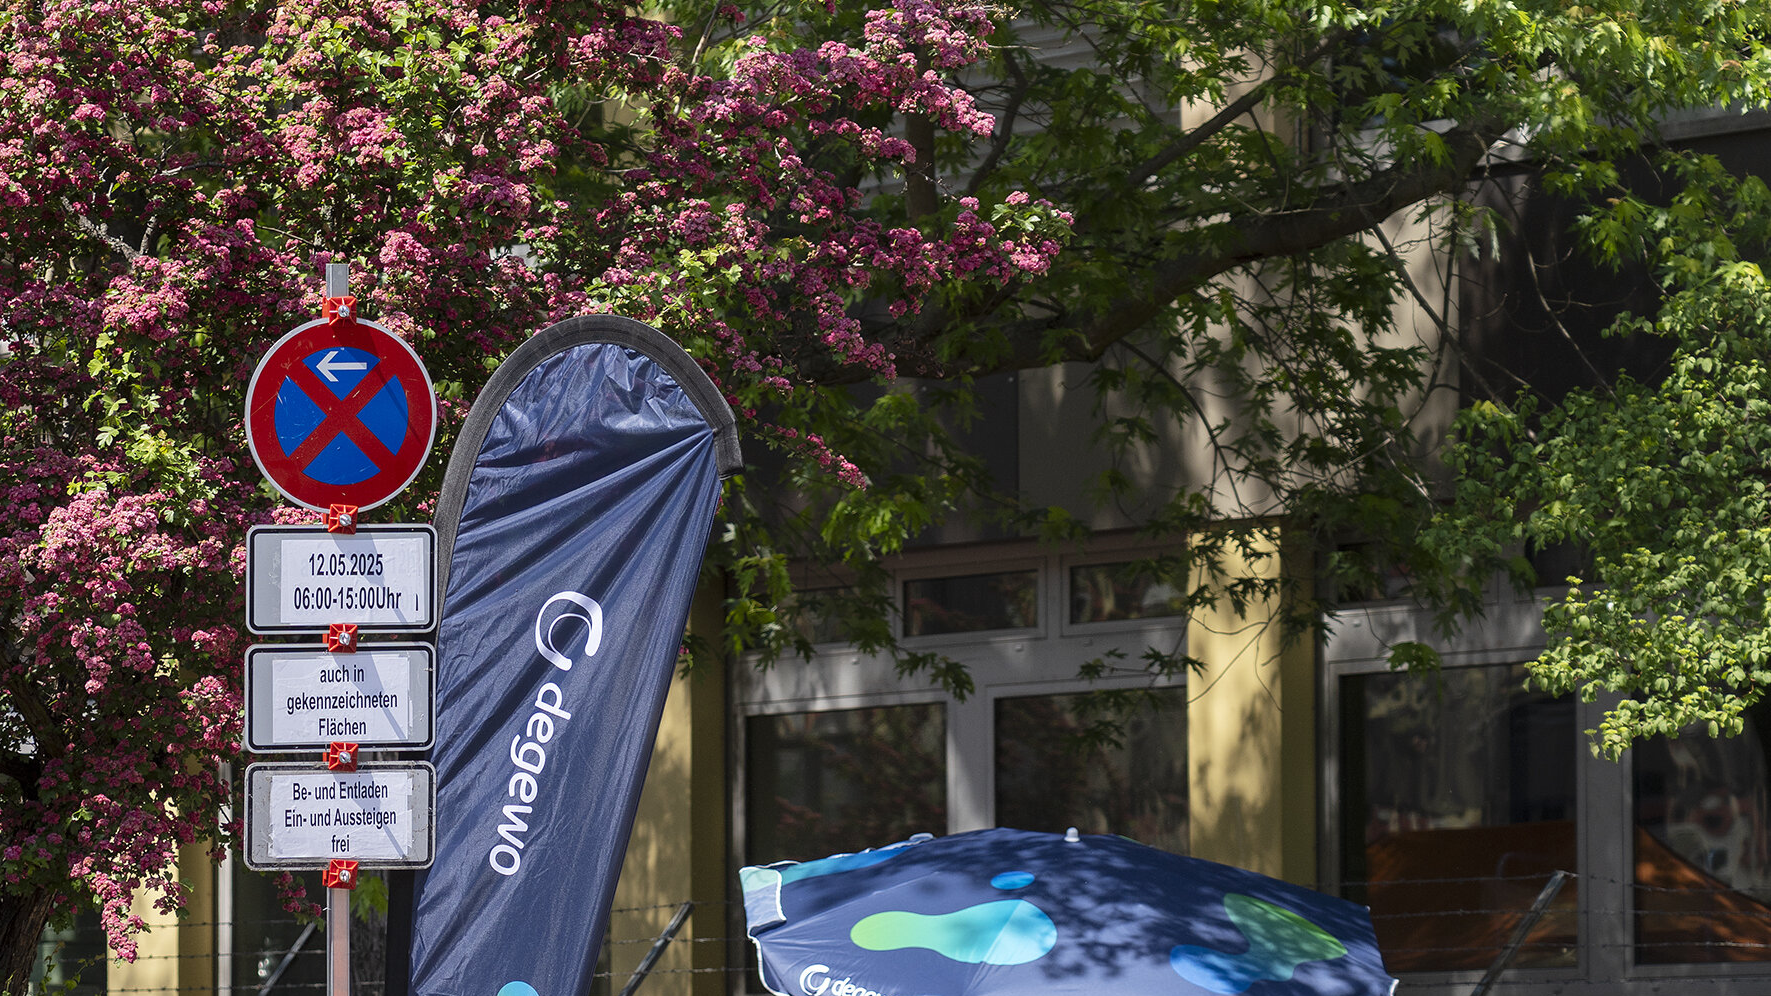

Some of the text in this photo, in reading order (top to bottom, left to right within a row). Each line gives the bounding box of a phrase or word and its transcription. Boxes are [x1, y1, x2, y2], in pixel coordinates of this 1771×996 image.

[309, 553, 384, 576] 12.05.2025
[294, 587, 402, 610] 06:00-15:00Uhr
[320, 664, 364, 683] auch in
[287, 691, 398, 715] gekennzeichneten
[318, 717, 367, 736] Flächen
[489, 682, 572, 876] degewo
[293, 781, 388, 801] Be- und Entladen
[284, 808, 397, 829] Ein- und Aussteigen
[331, 835, 350, 853] frei
